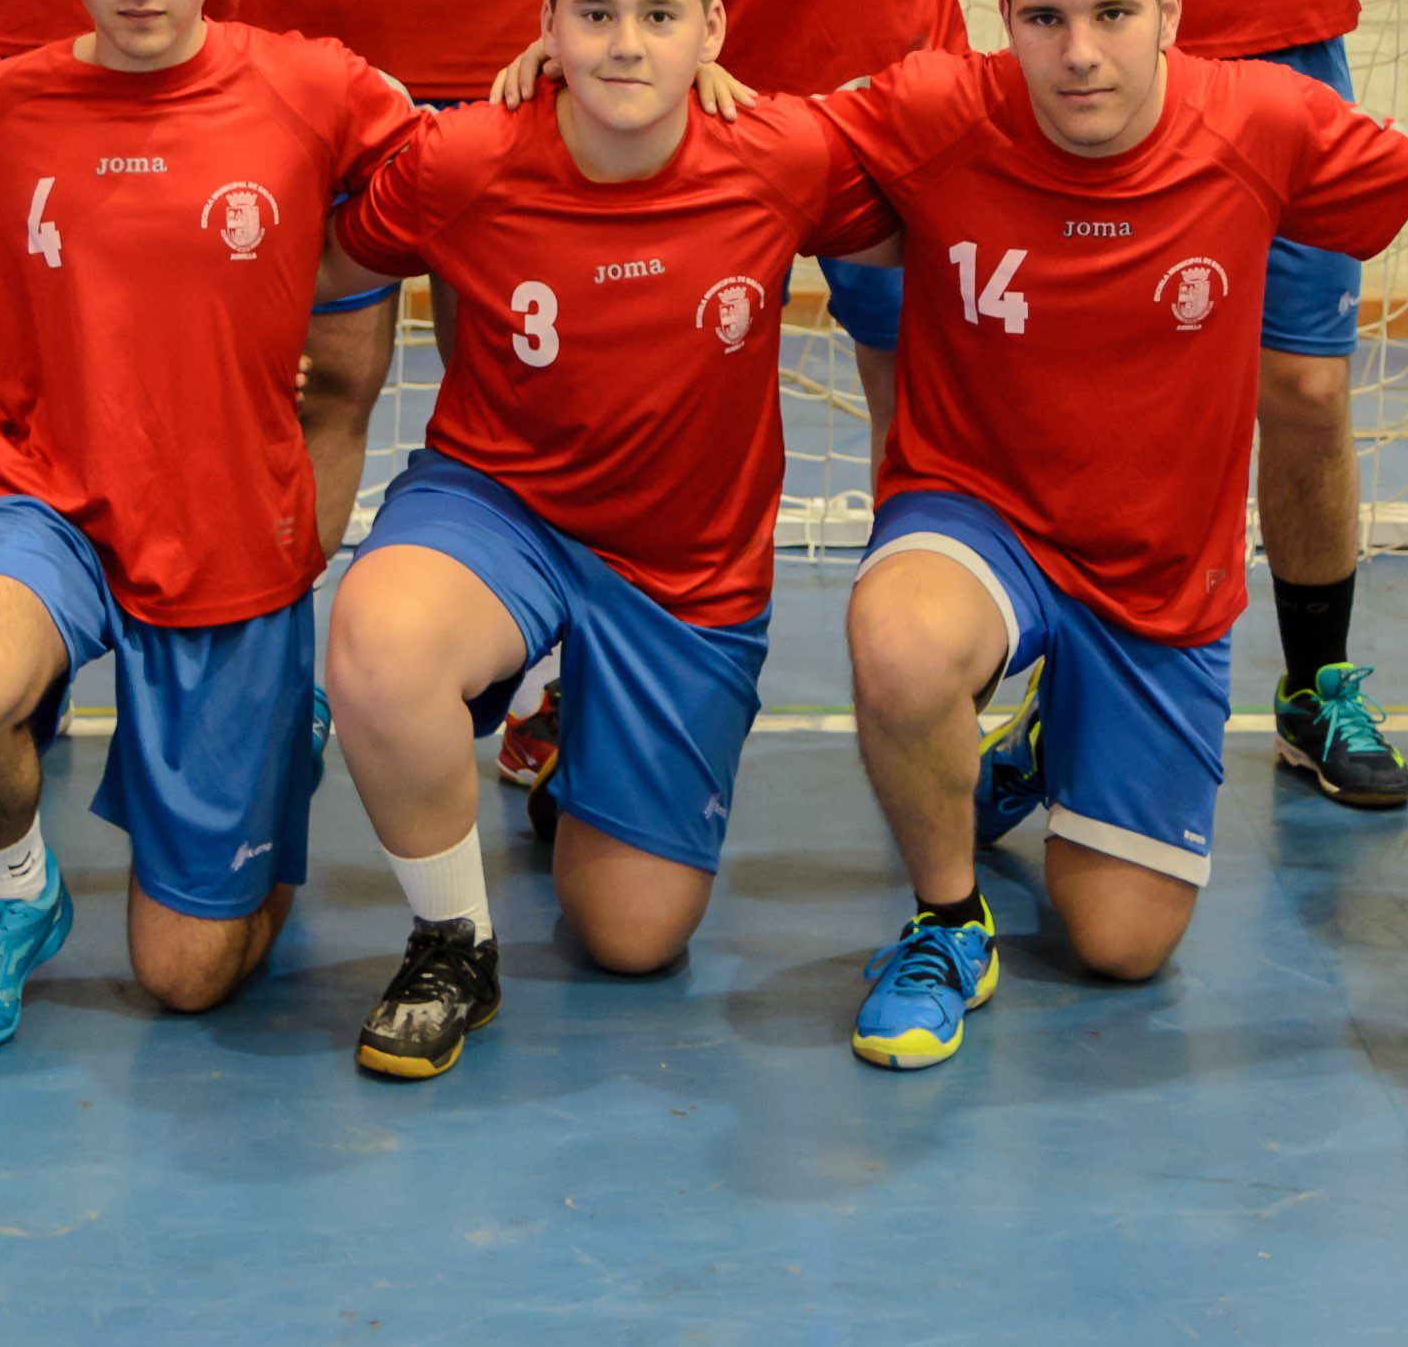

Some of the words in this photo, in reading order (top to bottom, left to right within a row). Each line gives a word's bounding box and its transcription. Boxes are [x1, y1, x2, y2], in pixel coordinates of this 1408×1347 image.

[27, 176, 62, 268] 4
[510, 280, 560, 368] 3
[948, 240, 1029, 335] 14
